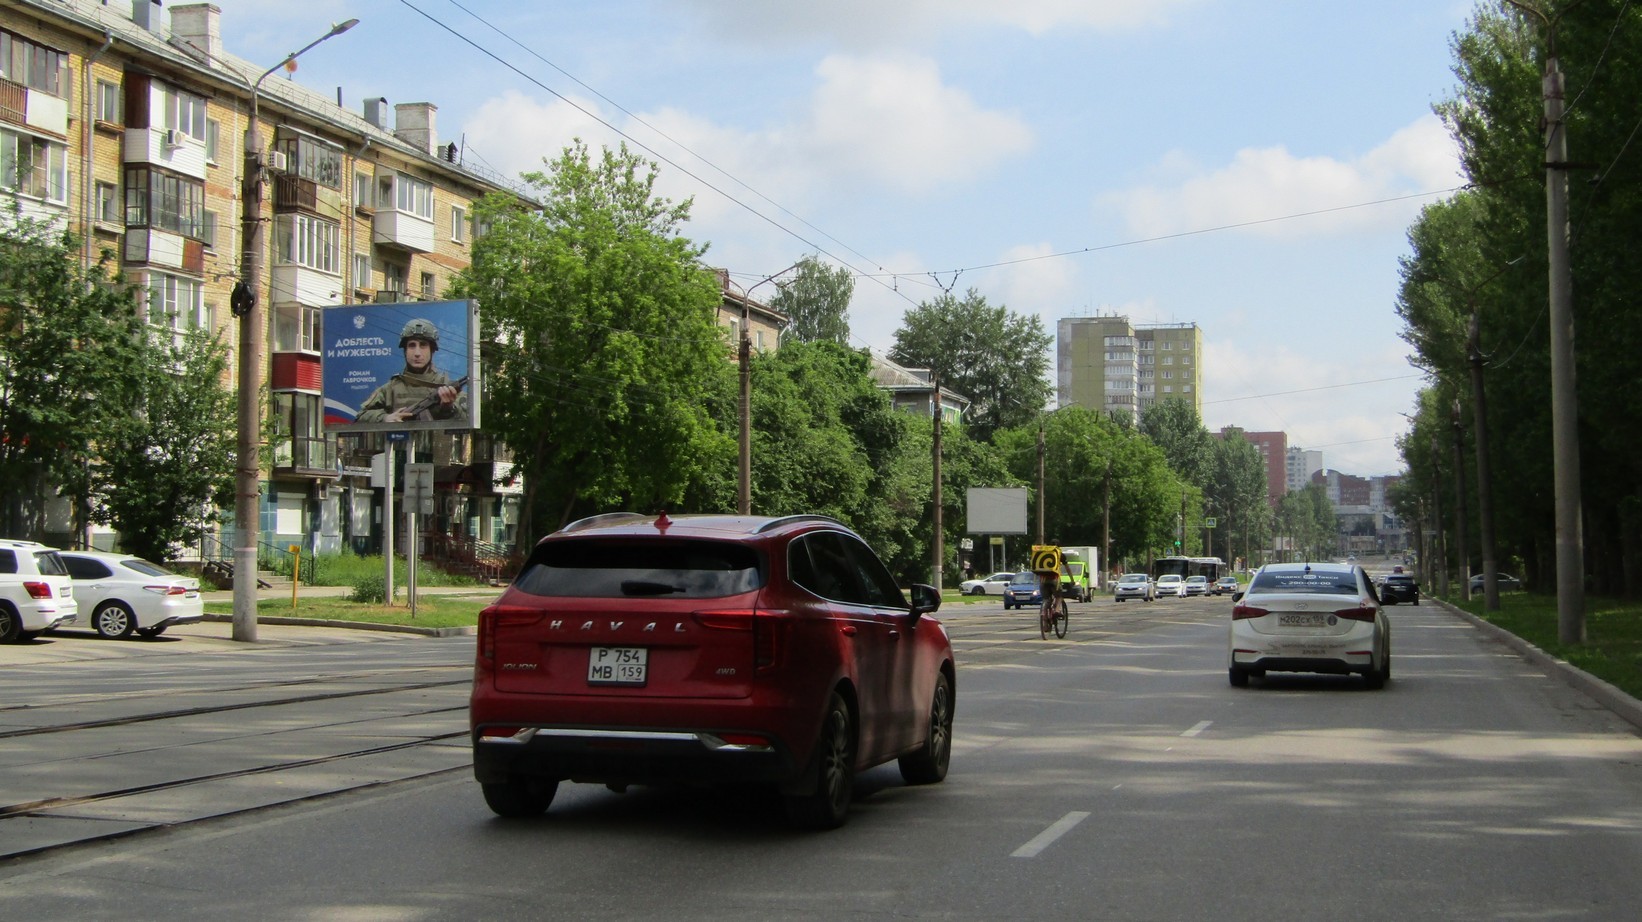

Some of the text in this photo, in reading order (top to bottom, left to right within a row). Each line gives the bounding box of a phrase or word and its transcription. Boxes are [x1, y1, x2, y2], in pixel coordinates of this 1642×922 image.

[335, 337, 384, 348] ДОБЛЕСТЬ
[328, 348, 392, 358] И МУЖЕСТВО!
[550, 619, 687, 632] HAVAL
[615, 649, 640, 663] 754
[621, 666, 642, 677] 159
[715, 668, 736, 676] 4WD
